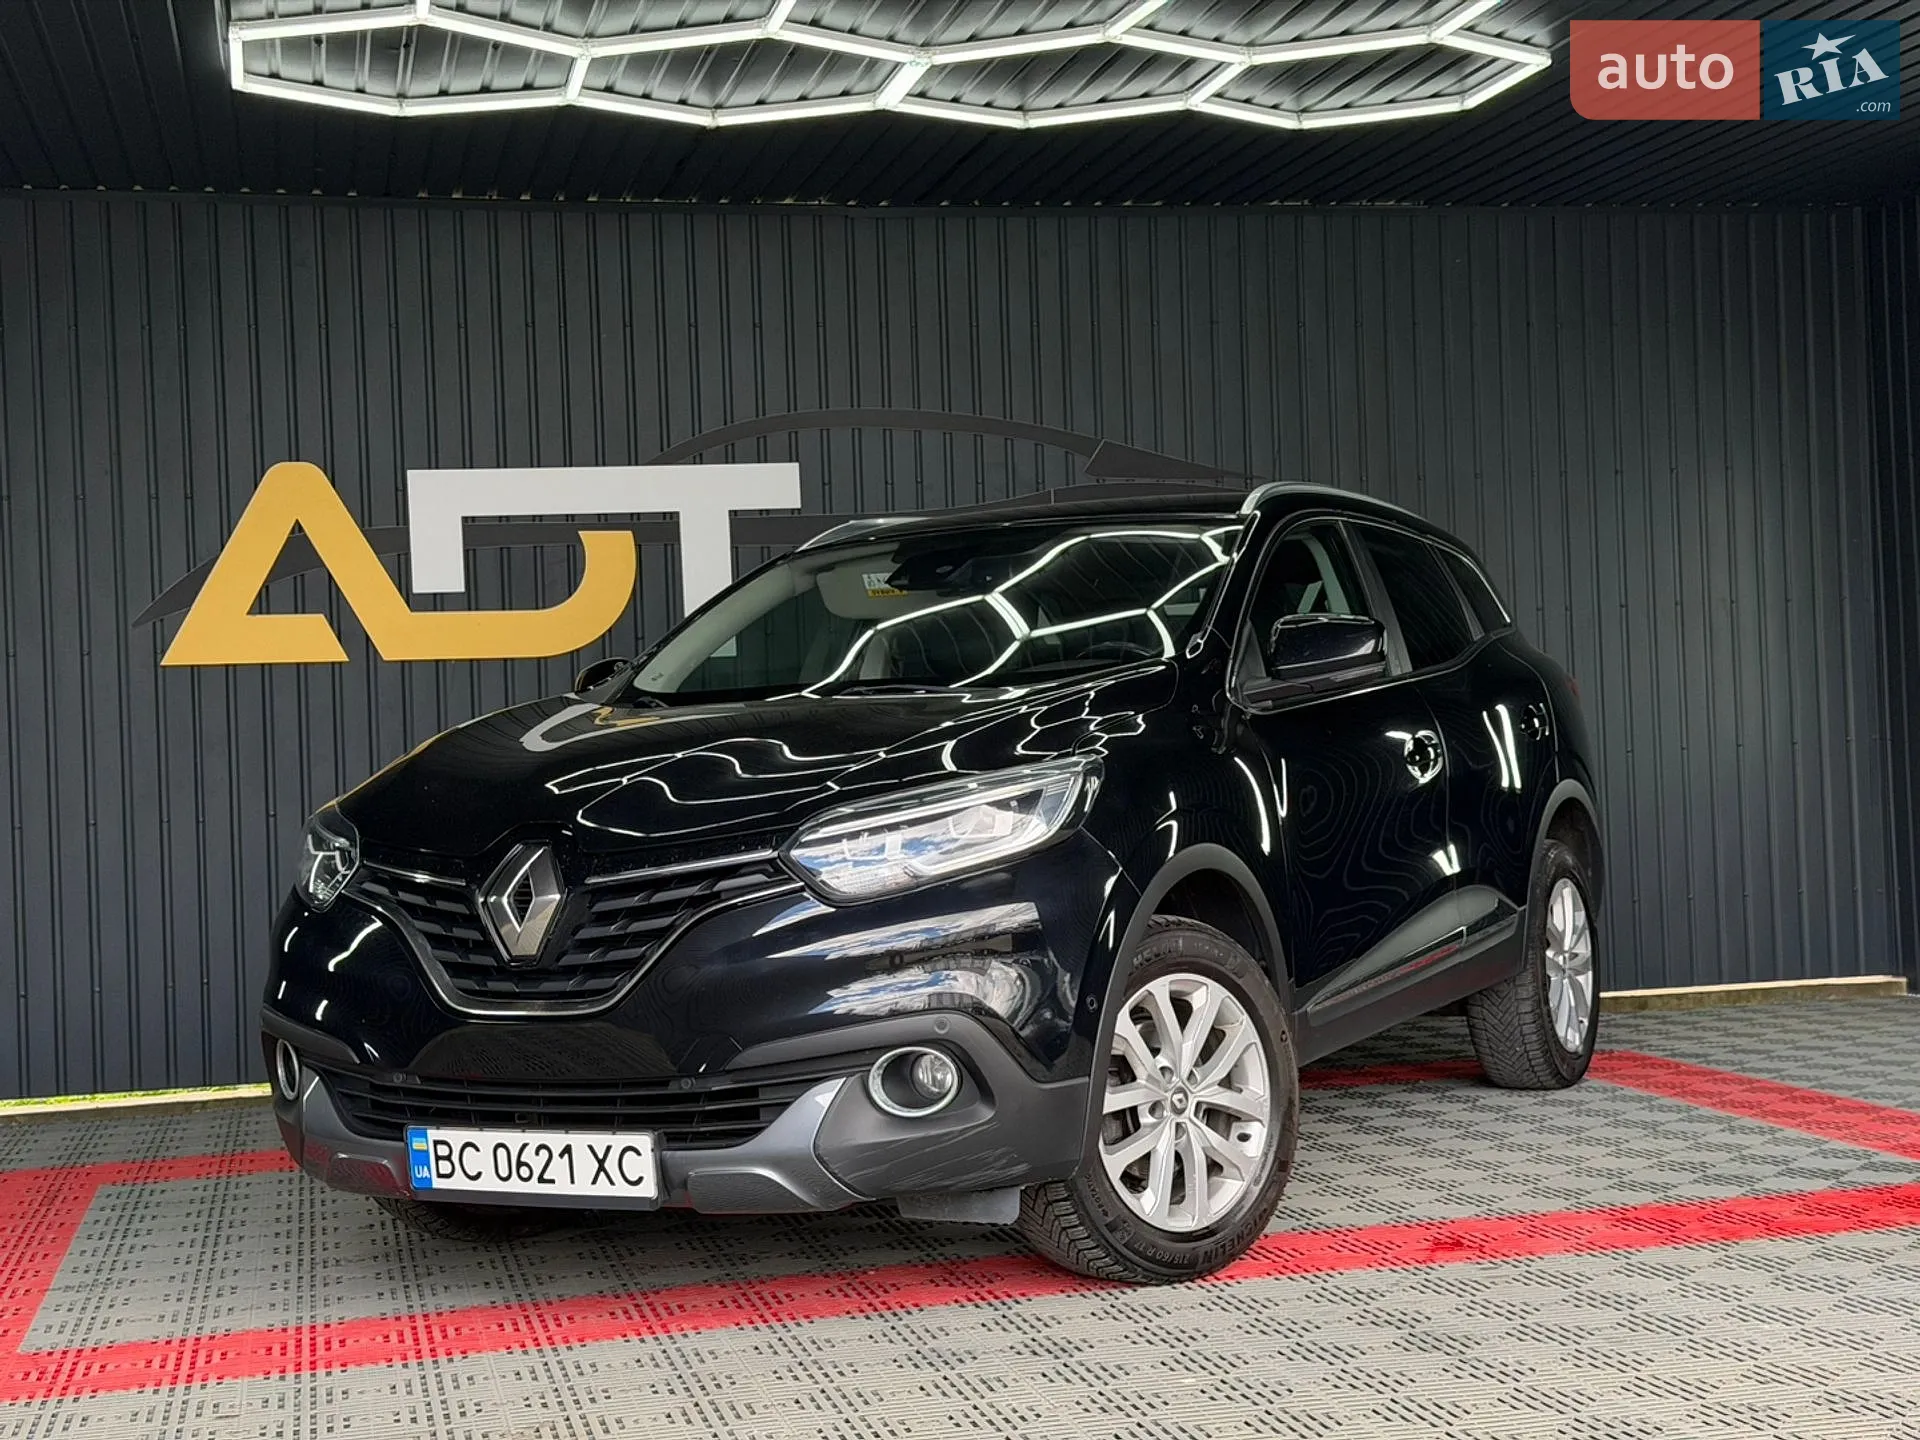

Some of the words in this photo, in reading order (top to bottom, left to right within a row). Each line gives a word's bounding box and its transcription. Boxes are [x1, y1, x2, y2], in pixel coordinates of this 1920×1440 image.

[161, 461, 802, 666] ADT
[414, 1165, 431, 1179] UA
[433, 1139, 482, 1181] BC
[491, 1142, 576, 1185] 0621
[586, 1144, 645, 1186] XC
